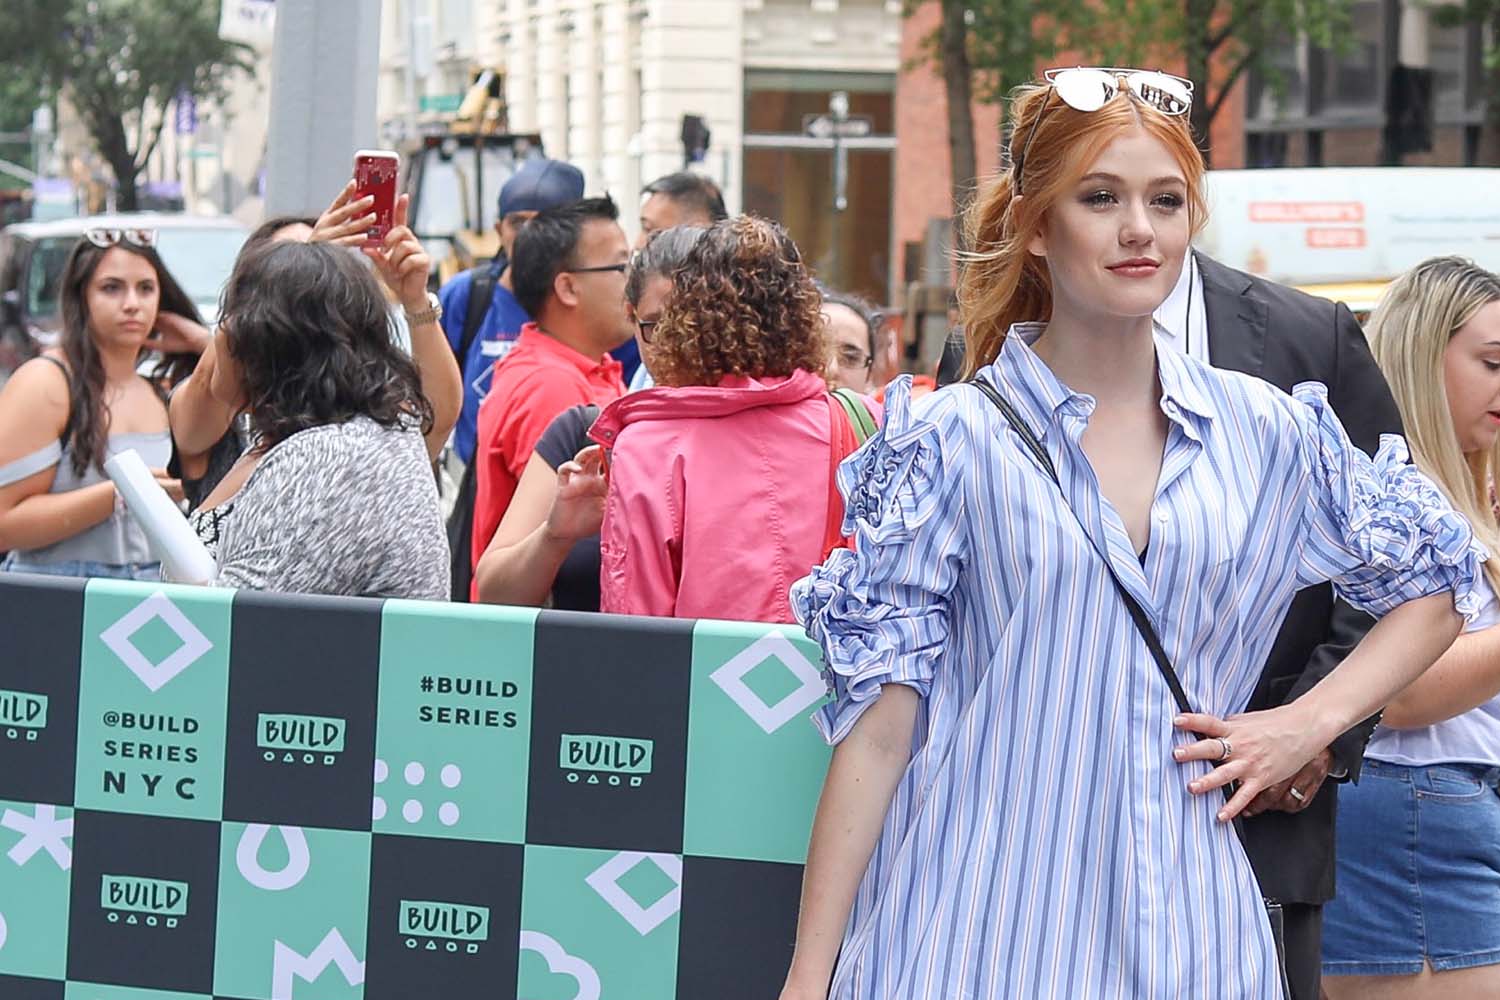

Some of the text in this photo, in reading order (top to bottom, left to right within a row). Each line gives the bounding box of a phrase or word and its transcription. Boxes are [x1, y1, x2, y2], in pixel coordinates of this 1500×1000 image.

[420, 675, 518, 698] #BUILD
[0, 693, 42, 723] ILD
[102, 710, 199, 734] @BUILD
[419, 705, 517, 728] SERIES
[265, 719, 339, 748] BUILD
[104, 740, 198, 764] SERIES
[568, 740, 646, 769] BUILD
[103, 770, 196, 800] NYC
[109, 881, 182, 910] BUILD
[407, 907, 483, 936] BUILD
